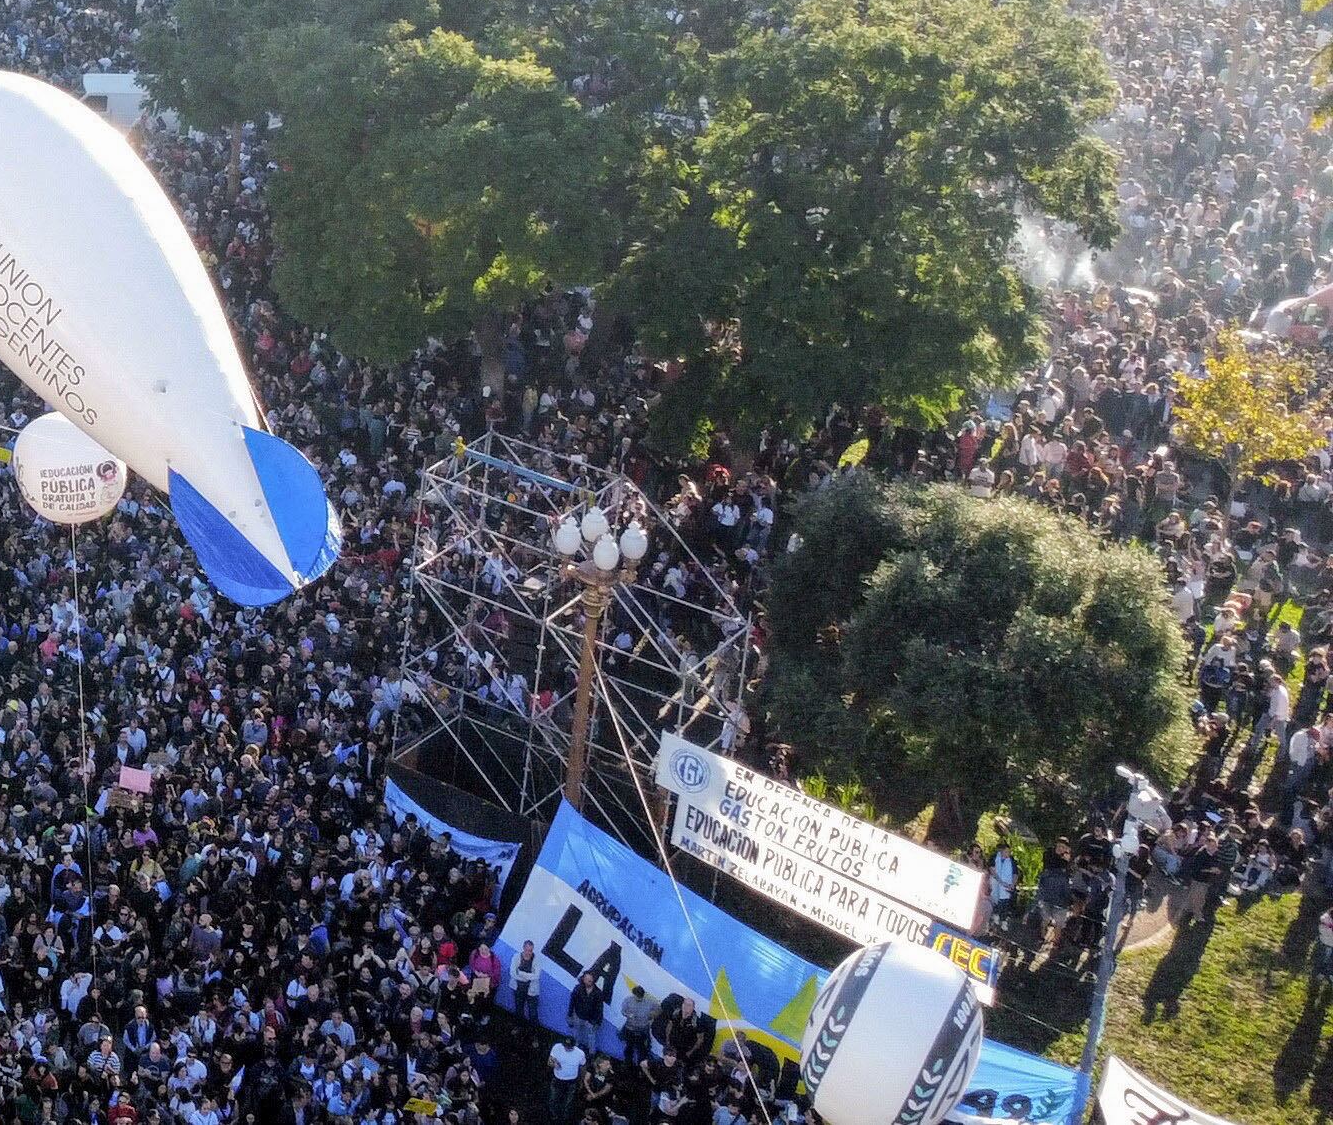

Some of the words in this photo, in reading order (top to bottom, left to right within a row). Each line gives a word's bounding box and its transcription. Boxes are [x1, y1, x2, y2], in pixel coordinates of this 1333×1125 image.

[42, 493, 86, 504] GRATUITA
[90, 492, 96, 500] Y
[43, 502, 54, 510] DE
[59, 501, 96, 511] CALIDAD
[735, 765, 755, 781] EN
[719, 798, 785, 846] GASTON
[793, 834, 864, 878] FRUTOS
[730, 862, 798, 906] ZELARAYAN
[828, 881, 869, 921] PARA
[876, 901, 930, 947] TODOS
[541, 902, 623, 1006] LA
